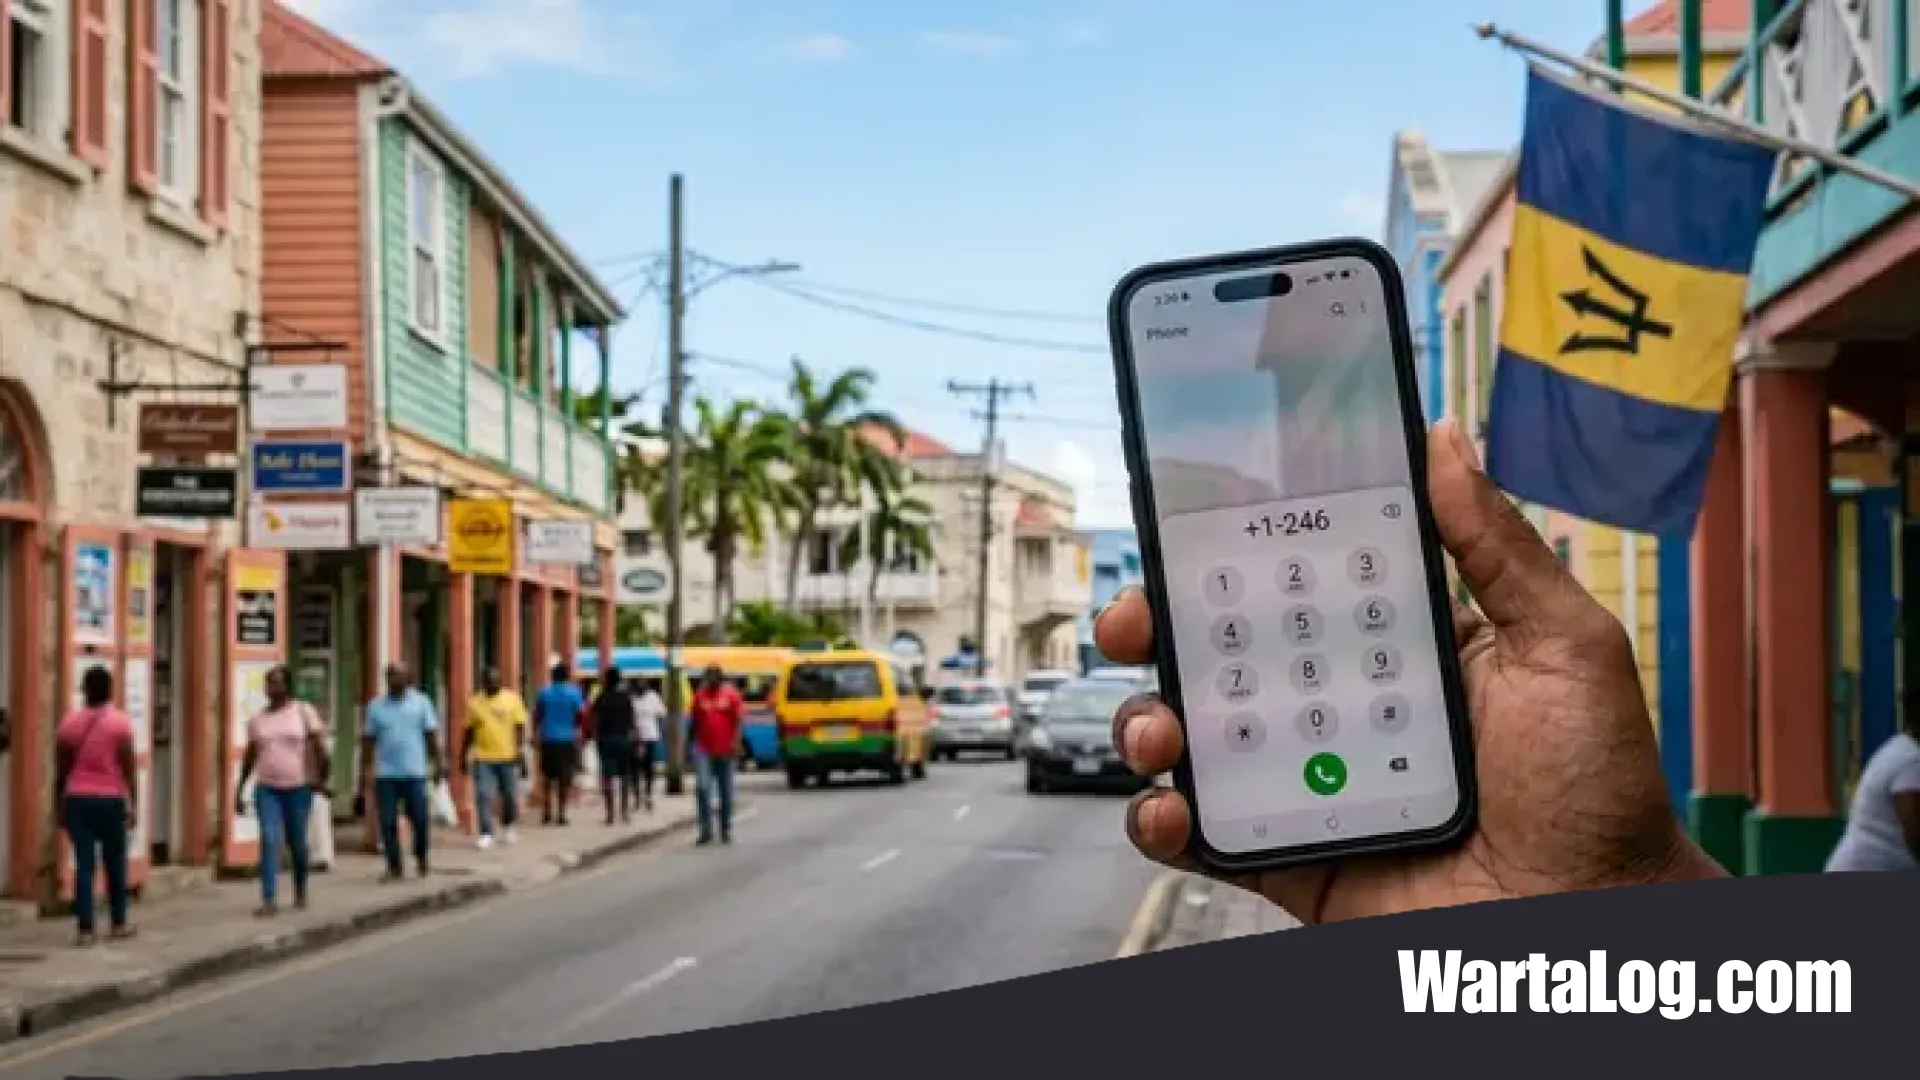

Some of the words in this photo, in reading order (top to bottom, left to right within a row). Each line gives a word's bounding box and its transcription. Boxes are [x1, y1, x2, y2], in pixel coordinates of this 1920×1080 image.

[1244, 508, 1331, 537] +1-246
[1360, 552, 1373, 571] 3
[1218, 572, 1229, 591] 1
[1288, 563, 1302, 582] 2
[1366, 600, 1382, 620] 6
[1223, 620, 1237, 639] 4
[1295, 611, 1310, 631] 5
[1303, 660, 1316, 679] 8
[1374, 651, 1388, 670] 9
[1231, 668, 1242, 687] 7
[1309, 709, 1324, 728] 0
